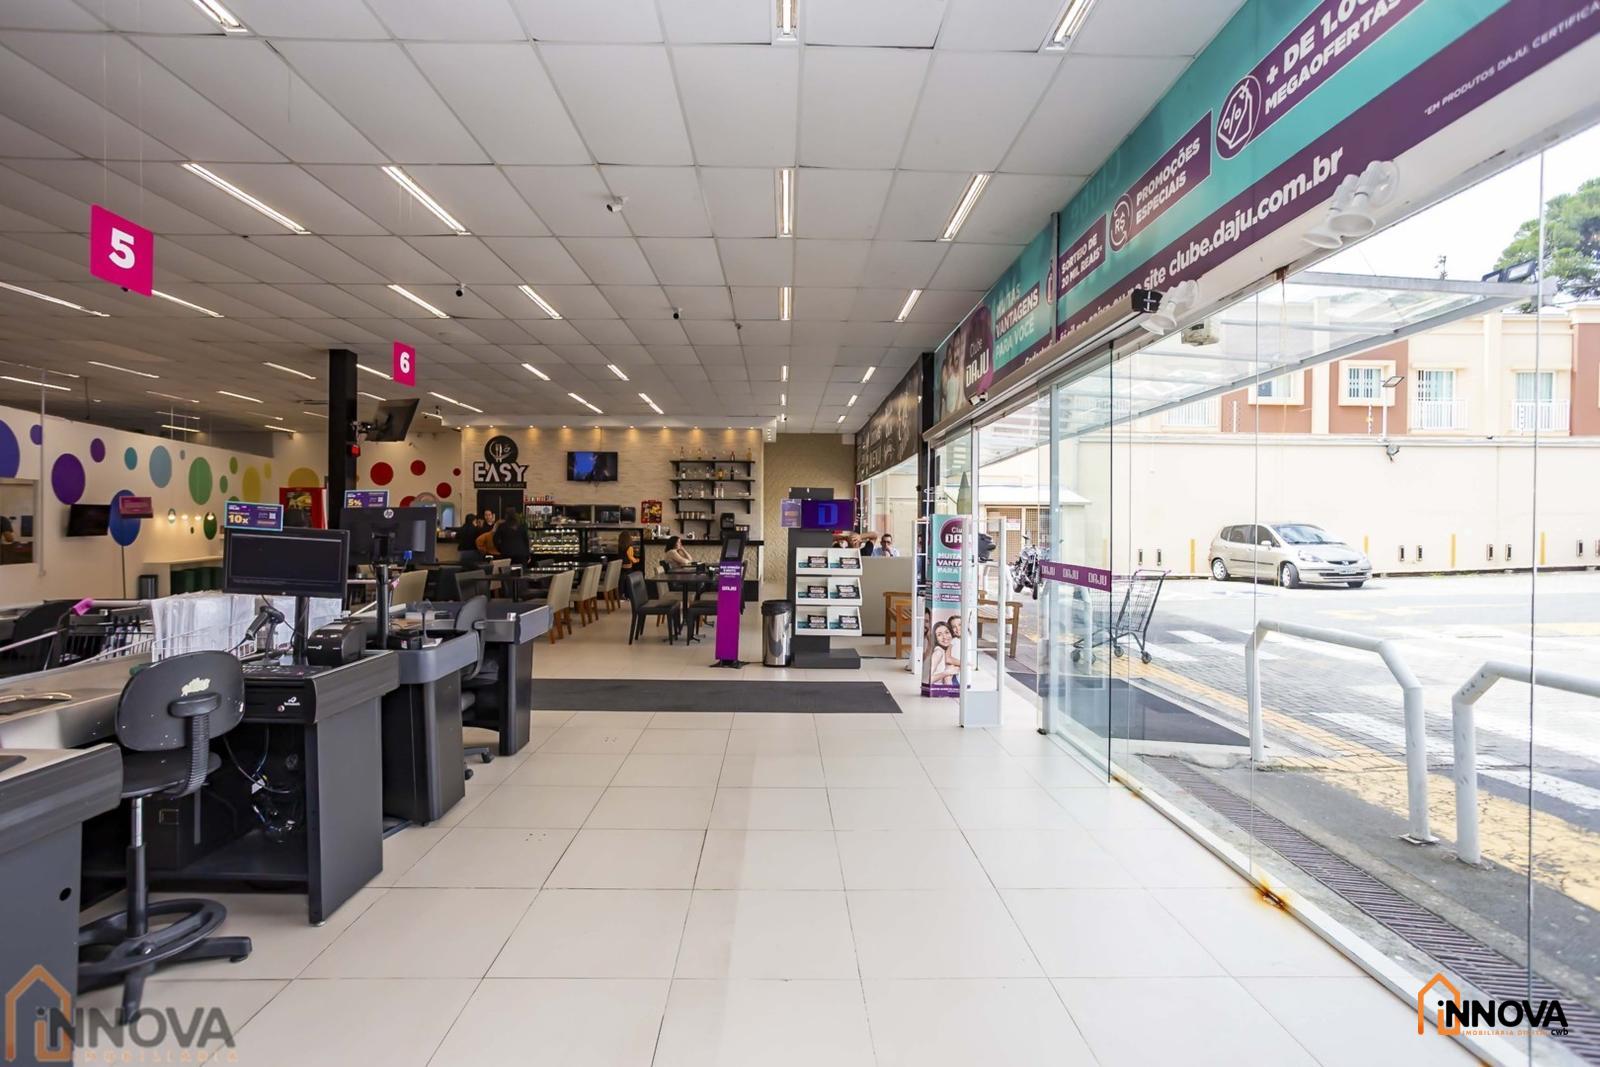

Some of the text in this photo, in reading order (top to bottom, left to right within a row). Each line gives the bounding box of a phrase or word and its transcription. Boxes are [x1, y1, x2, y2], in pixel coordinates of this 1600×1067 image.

[1284, 25, 1315, 74] DE
[1320, 0, 1369, 39] 1.0
[1442, 66, 1495, 106] PRODUTOS
[1136, 137, 1200, 206] PROMOÇÕES
[1136, 171, 1187, 225] ESPECIAIS
[1114, 211, 1126, 234] R$
[1143, 264, 1166, 291] site
[1169, 146, 1343, 277] clube.daju.com.br
[108, 227, 136, 269] 5
[1061, 232, 1098, 275] SORTEIO DE
[1061, 274, 1070, 289] 20
[1070, 265, 1080, 282] MIL
[995, 288, 1039, 338] VANTAGENS
[400, 351, 410, 374] 6
[966, 348, 990, 388] DAJU
[473, 462, 526, 482] EASY
[228, 514, 249, 524] 10x
[945, 533, 963, 543] DA
[937, 559, 963, 567] VANTA
[1041, 565, 1107, 586] DAJU DAJU DAJU
